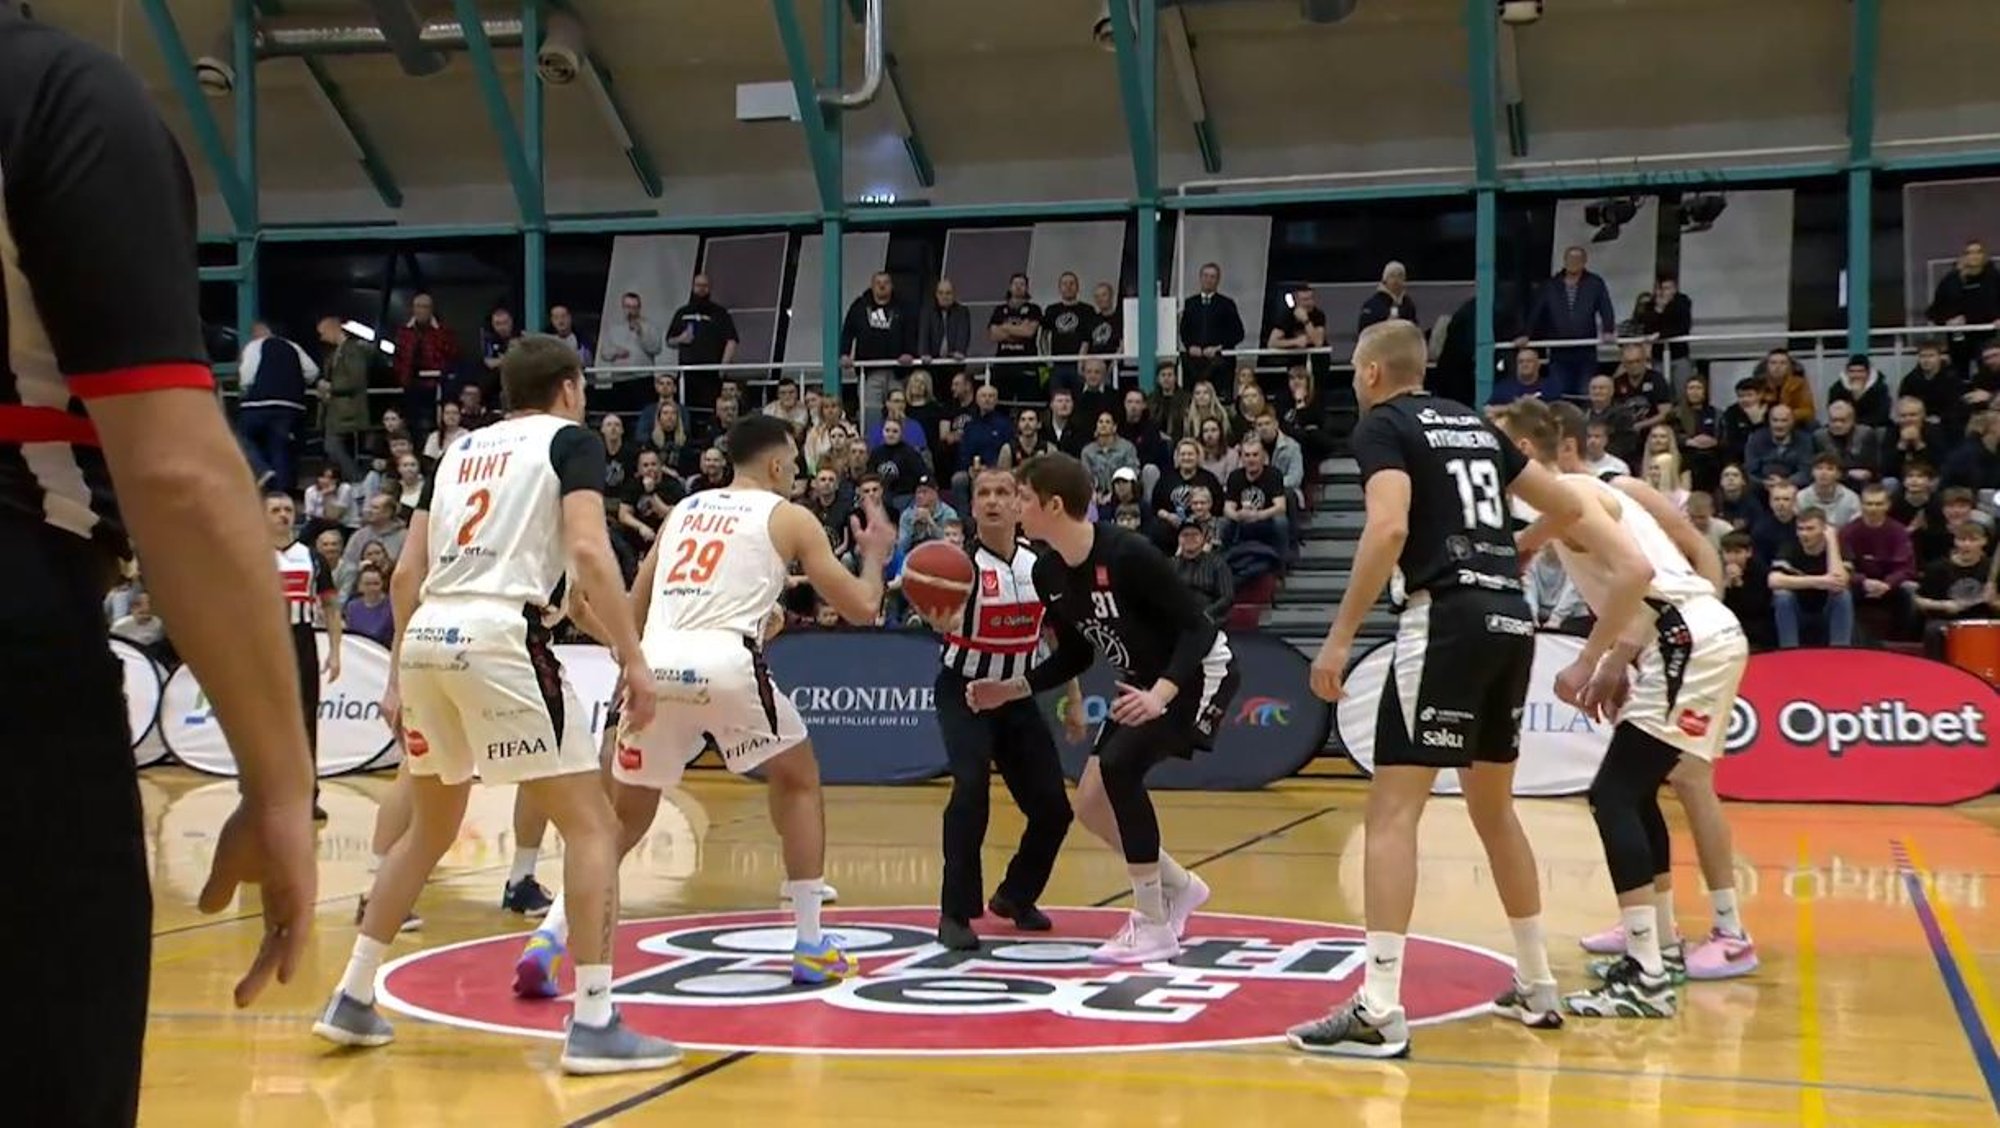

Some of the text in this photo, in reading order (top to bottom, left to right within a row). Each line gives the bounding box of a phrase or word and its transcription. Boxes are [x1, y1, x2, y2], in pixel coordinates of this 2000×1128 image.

[458, 451, 512, 484] HINT
[1445, 458, 1503, 530] 13
[458, 488, 490, 546] 2
[680, 512, 740, 535] PAJIC
[667, 538, 724, 584] 29
[1091, 591, 1120, 618] 31
[789, 686, 937, 711] CRONIME
[1529, 702, 1595, 733] ILA
[1779, 700, 1986, 754] Optibet
[487, 737, 547, 760] FIFAA
[1422, 728, 1464, 748] saku
[637, 921, 1367, 981] Opti
[604, 953, 1238, 1021] bet
